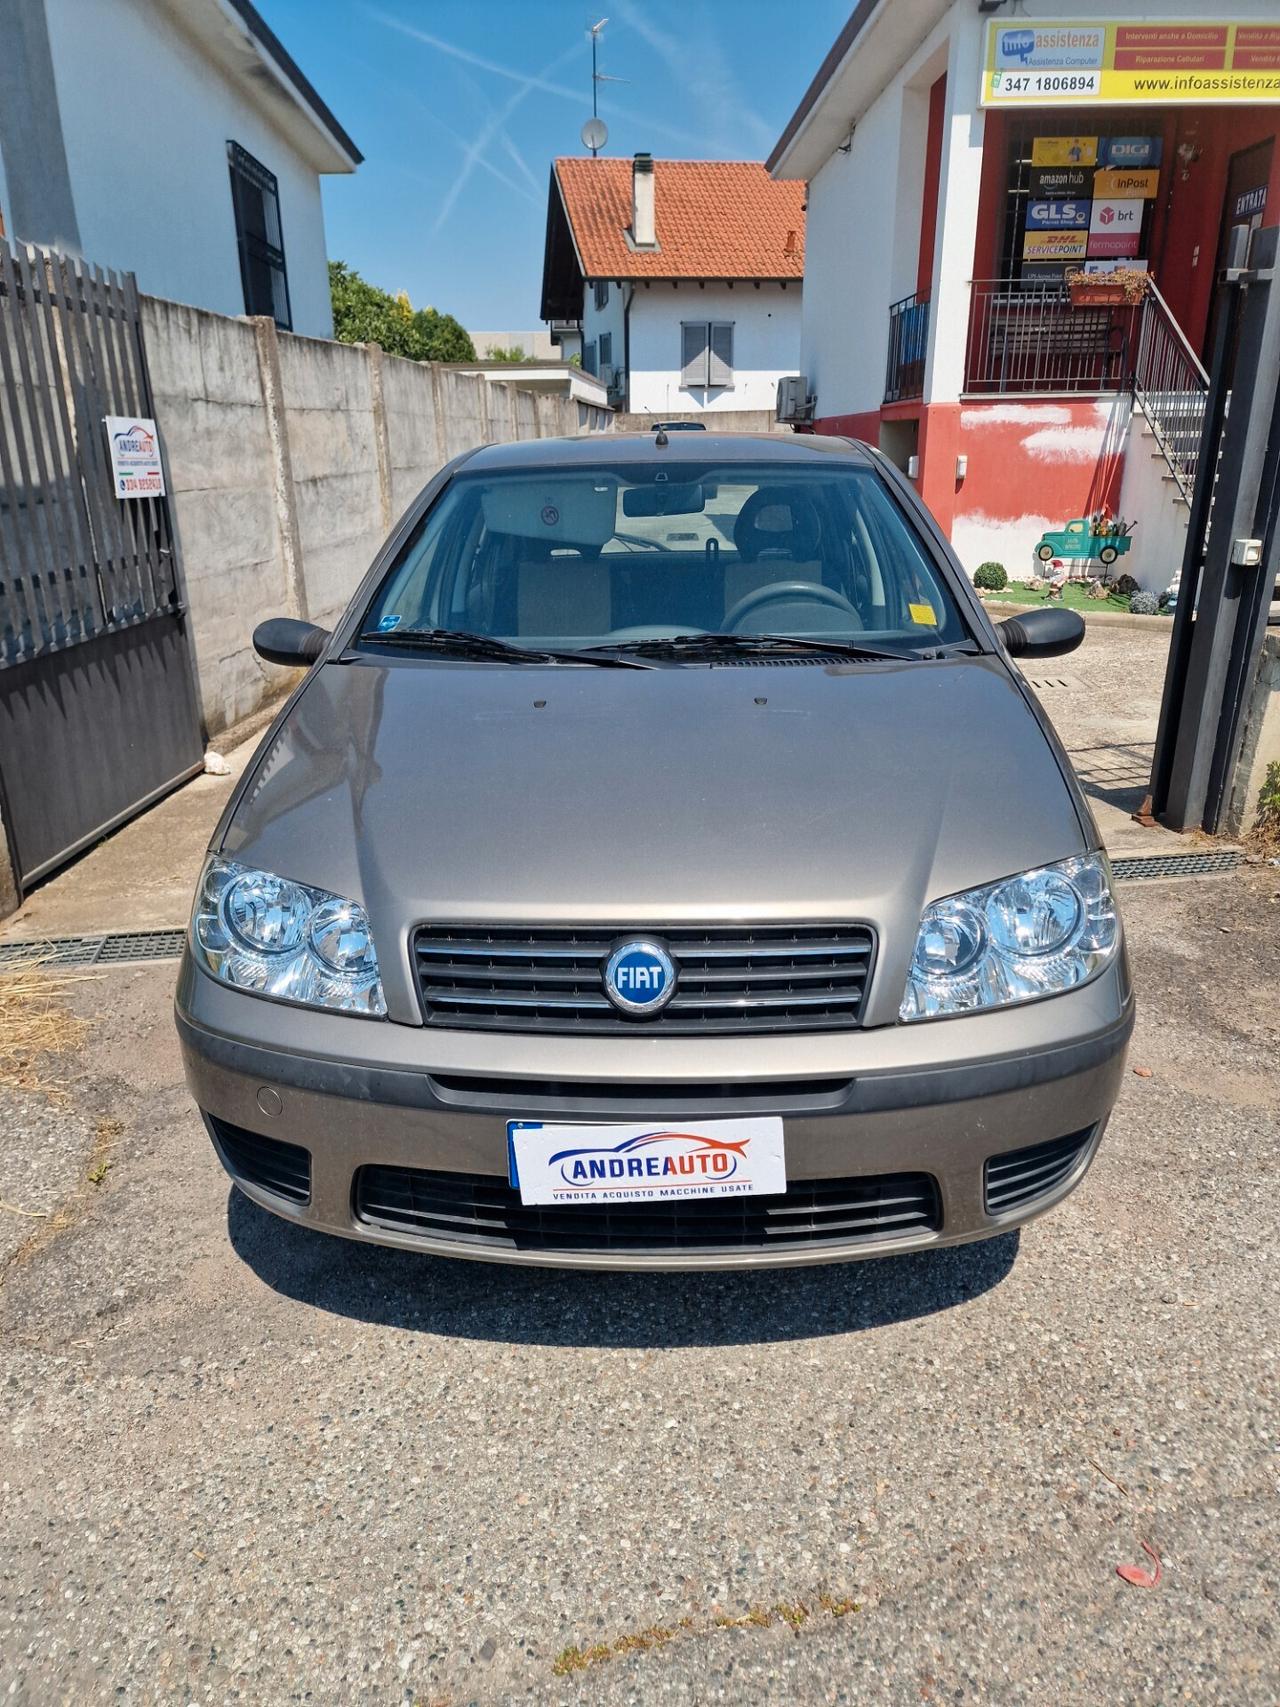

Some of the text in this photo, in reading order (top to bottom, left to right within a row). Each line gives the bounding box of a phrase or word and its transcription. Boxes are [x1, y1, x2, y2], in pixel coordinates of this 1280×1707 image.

[1036, 30, 1100, 49] assistenza
[1028, 56, 1098, 67] Assistenza Computer
[1135, 55, 1205, 65] Riparazione Cellulari
[1005, 76, 1095, 92] 347 1806894
[1134, 74, 1280, 90] www.infoassistenza
[1111, 144, 1150, 155] DIGI
[1039, 171, 1084, 185] amazon hub
[1117, 177, 1149, 189] InPost
[1236, 187, 1267, 215] ENTRATA
[1031, 203, 1077, 220] GLS
[1117, 210, 1134, 221] brt
[1046, 235, 1079, 244] DHL
[1089, 240, 1138, 250] fermopoint
[1027, 244, 1083, 255] SERVICEPOINT
[119, 439, 153, 453] ANDREAUTO
[617, 966, 662, 989] FIAT
[572, 1153, 729, 1179] ANDREAUTO
[553, 1184, 753, 1201] VENDITA ACQUISTO MACCHINE USATE
